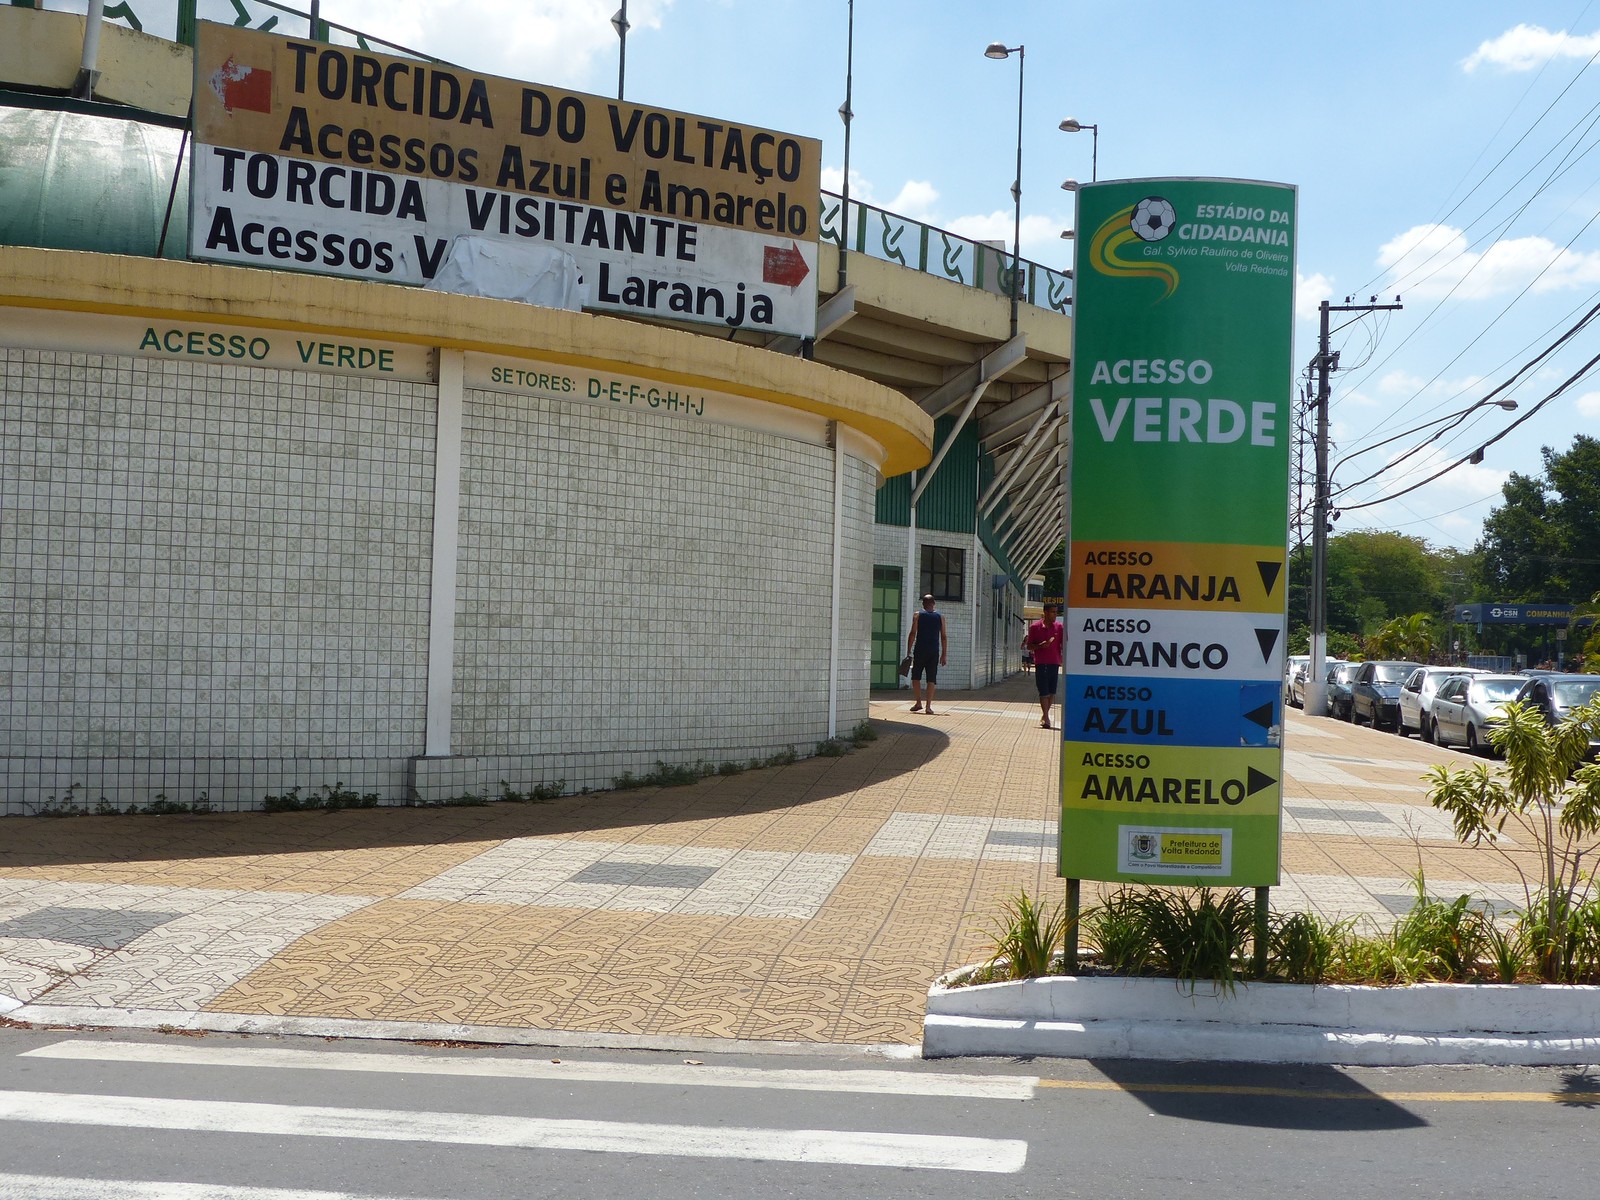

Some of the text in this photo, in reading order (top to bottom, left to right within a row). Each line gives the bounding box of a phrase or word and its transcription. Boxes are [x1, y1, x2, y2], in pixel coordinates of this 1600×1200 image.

[286, 41, 801, 185] TORCIDA DO VOLTAÇO
[279, 106, 807, 236] Acessos Azul e Amarelo
[213, 147, 427, 223] TORCIDA
[465, 188, 698, 262] VISITANTE
[1196, 202, 1290, 225] ESTÁDIO DA
[205, 205, 394, 274] Acessos
[1178, 223, 1289, 247] CIDADANIA
[1143, 245, 1289, 262] Gal. Sylvio Raulino de Oliveira
[1225, 261, 1288, 277] Volta Redonda
[598, 262, 774, 327] Laranja
[139, 327, 395, 372] ACESSO VERDE
[491, 367, 576, 392] SETORES:
[1090, 359, 1213, 385] ACESSO
[1089, 397, 1276, 447] VERDE
[1084, 551, 1153, 567] ACESSO
[1086, 573, 1241, 602] LARANJA
[1083, 618, 1151, 633] ACESSO
[1084, 640, 1229, 670] BRANCO
[1083, 685, 1153, 701] ACESSO
[1083, 707, 1174, 736] AZUL
[1081, 753, 1150, 769] ACESSO
[1081, 774, 1246, 806] AMARELO
[1161, 847, 1220, 856] Volta Redonda
[1170, 840, 1220, 848] Prefeitura de
